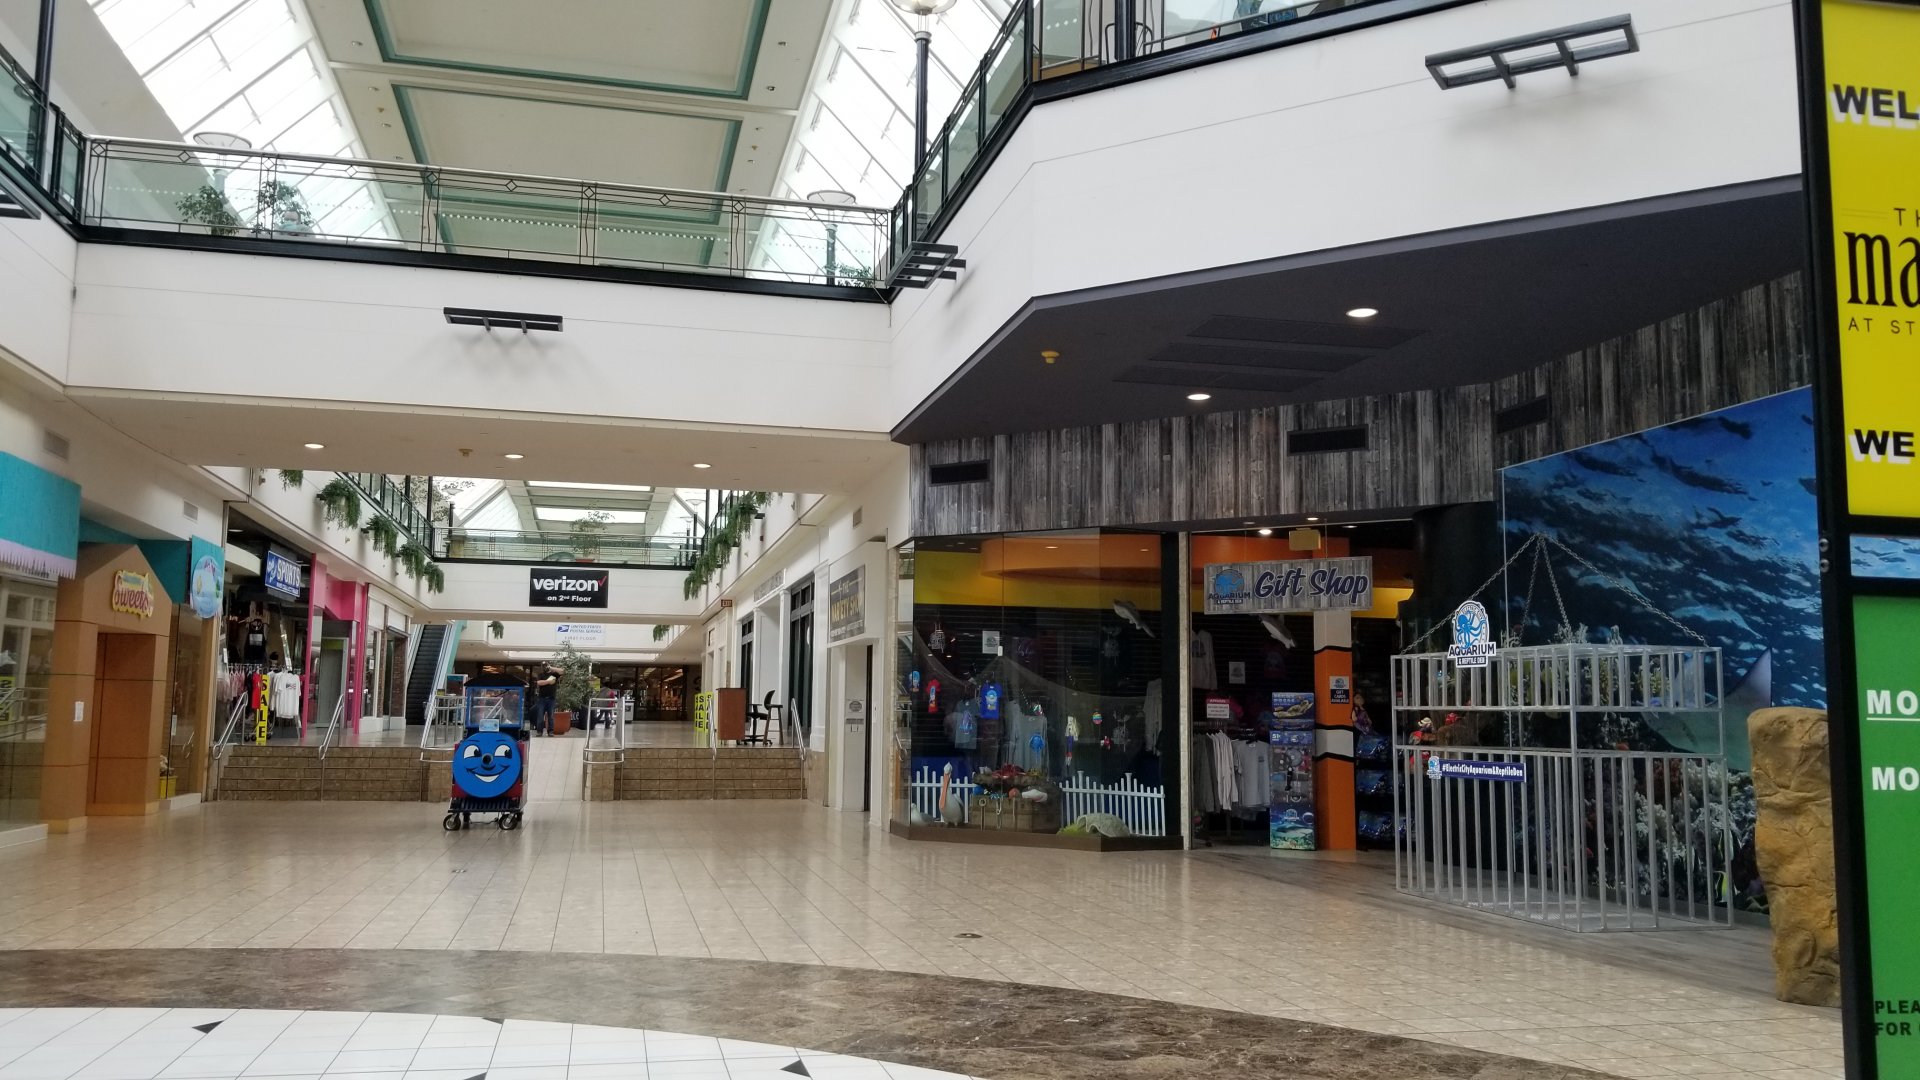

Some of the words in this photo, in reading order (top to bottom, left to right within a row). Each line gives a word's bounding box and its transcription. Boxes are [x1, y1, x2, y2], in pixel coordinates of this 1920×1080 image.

[1832, 84, 1920, 121] WEL
[1848, 317, 1873, 334] AT
[1890, 320, 1917, 335] ST
[1854, 428, 1915, 457] WE
[277, 558, 301, 588] SPORTS
[533, 576, 599, 592] verizon
[1208, 591, 1251, 600] AQUARIUM
[1255, 568, 1306, 598] Gift
[1310, 568, 1368, 604] Shop
[1449, 643, 1495, 657] AQUARIUM
[258, 679, 268, 739] SALE
[1866, 689, 1918, 716] MO
[1871, 767, 1919, 792] MO
[1874, 1000, 1920, 1015] PLEA
[1873, 1022, 1912, 1036] FOR
